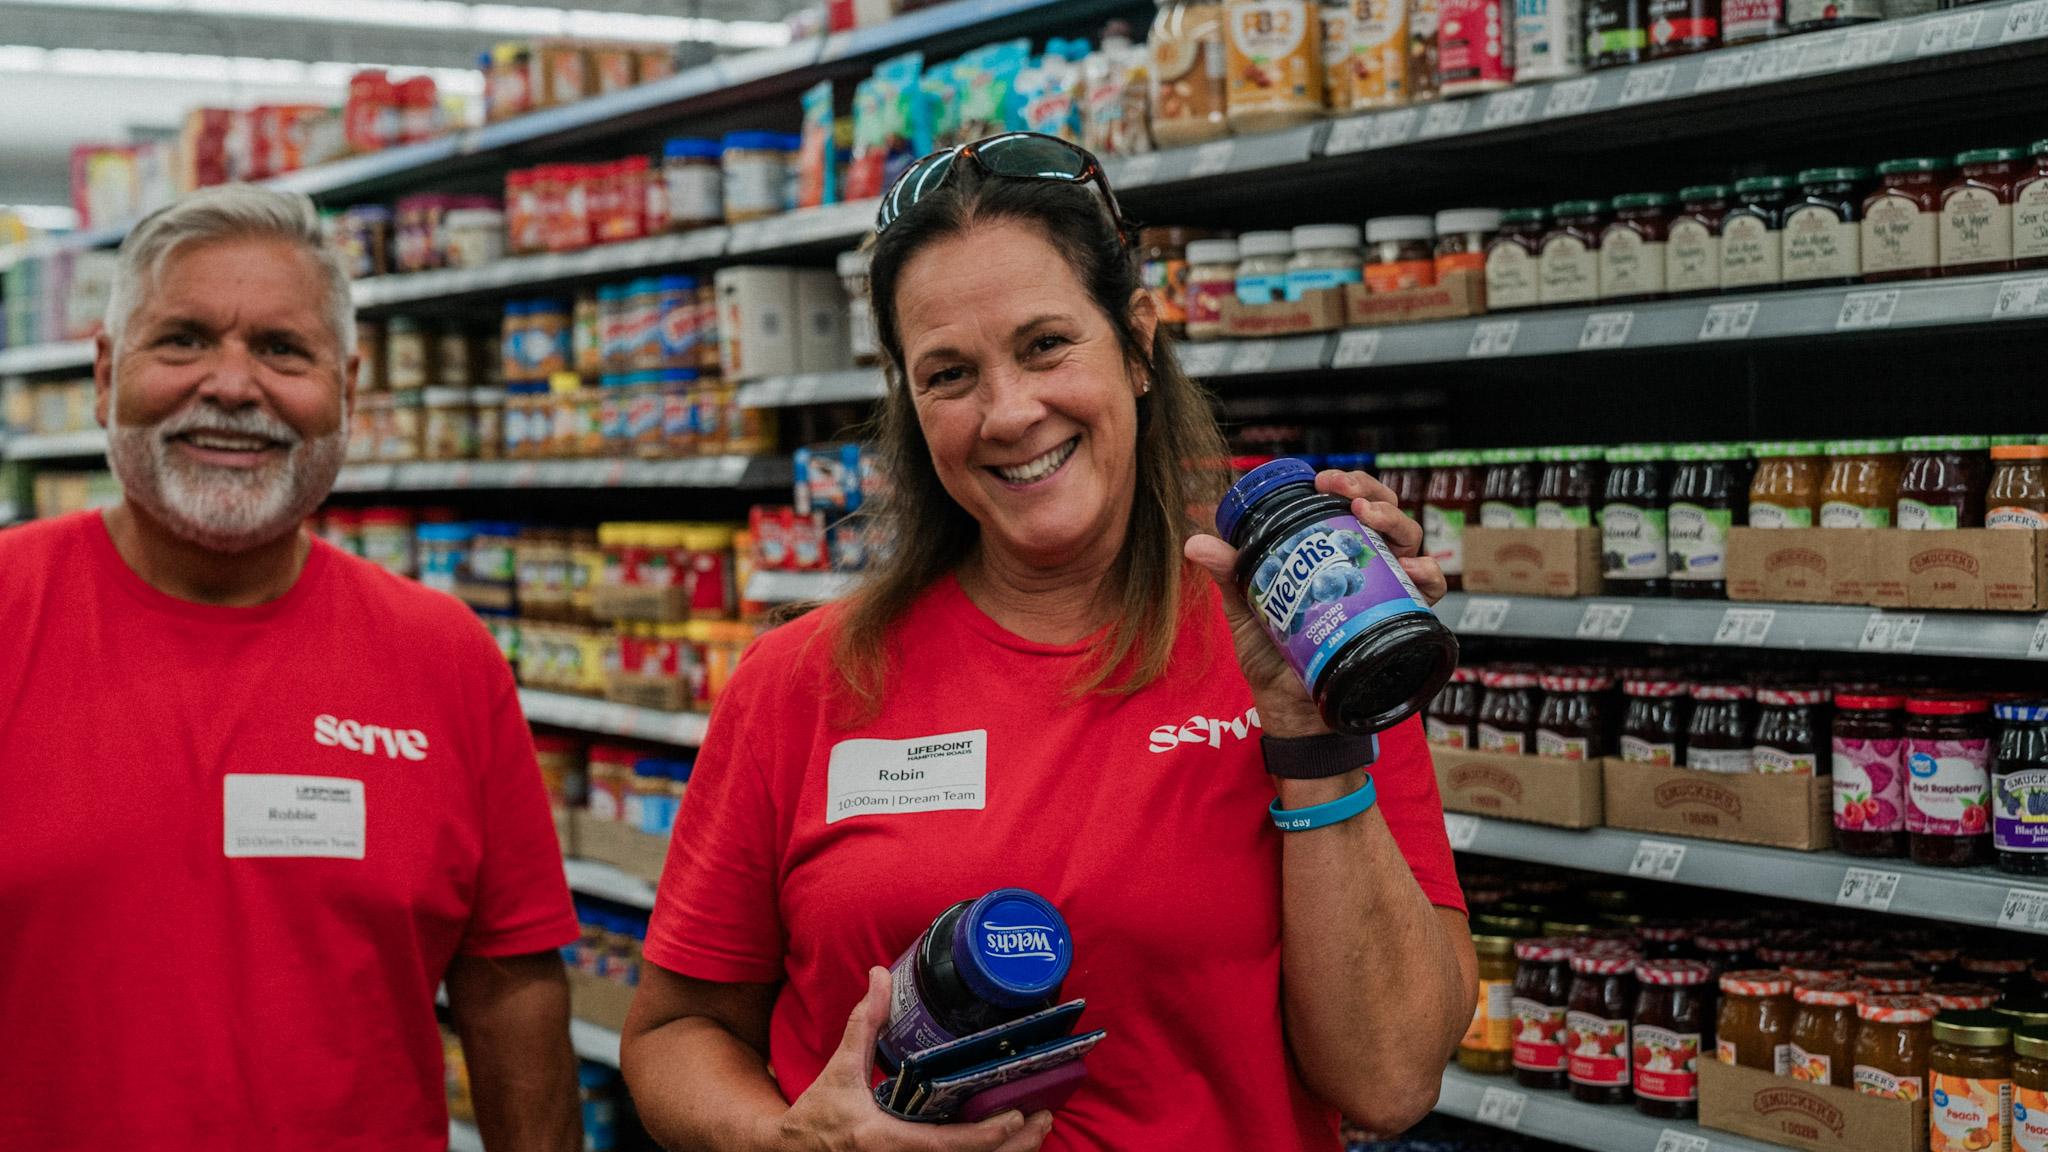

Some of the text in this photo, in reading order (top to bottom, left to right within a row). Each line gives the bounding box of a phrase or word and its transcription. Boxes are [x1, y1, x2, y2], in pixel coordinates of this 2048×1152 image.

[1913, 551, 1975, 570] SMUCKER'S
[1264, 536, 1336, 626] Welch's
[1305, 602, 1344, 639] CONCORD
[1312, 610, 1348, 646] GRAPE
[1327, 630, 1346, 649] JAM
[314, 713, 429, 761] serve
[907, 740, 974, 756] LIFEPOINT
[907, 749, 973, 761] HAMPTON ROADS
[879, 768, 925, 781] Robin
[2007, 774, 2048, 788] SMUCK
[1834, 779, 1860, 791] berry
[1914, 783, 1983, 795] Red Raspberry
[838, 796, 889, 811] 10:00am
[898, 793, 940, 805] Dream
[943, 790, 976, 800] Team
[268, 807, 317, 821] Robbie
[1292, 818, 1311, 828] day
[986, 932, 1053, 953] Welch's
[1760, 1091, 1838, 1124] SMUCKER'S
[1946, 1108, 1980, 1121] Peach
[1788, 1121, 1819, 1140] DOZEN
